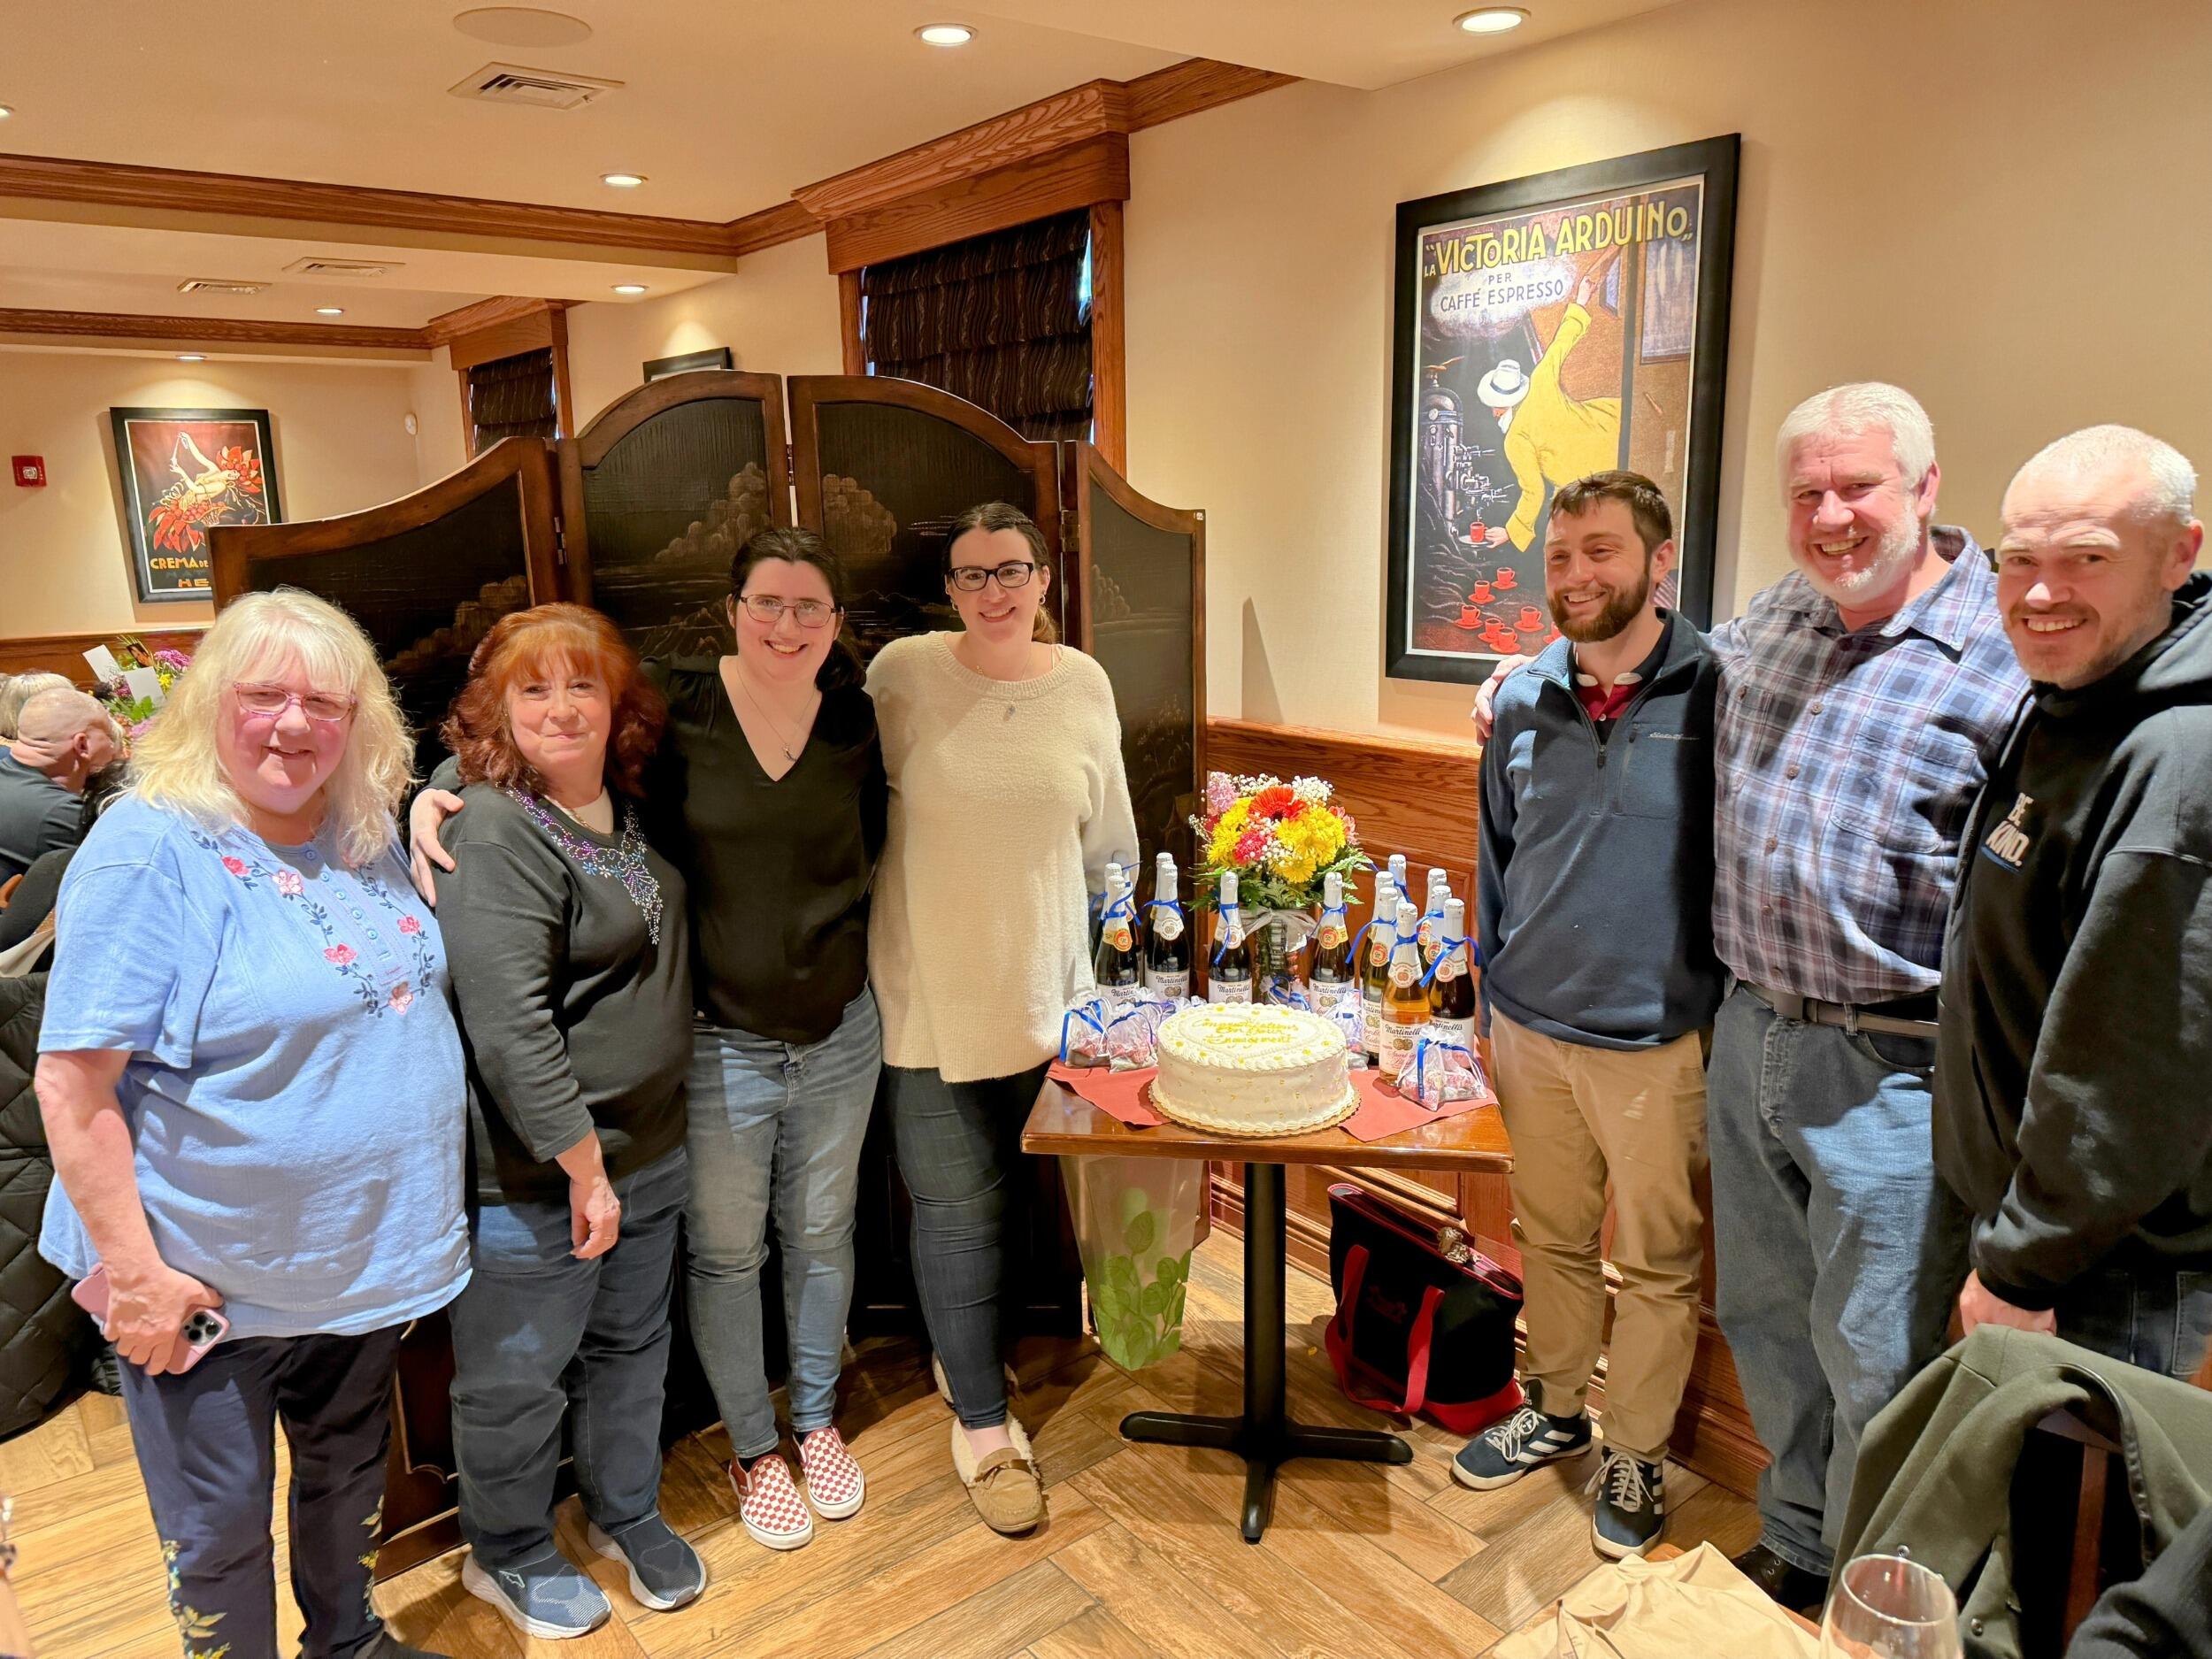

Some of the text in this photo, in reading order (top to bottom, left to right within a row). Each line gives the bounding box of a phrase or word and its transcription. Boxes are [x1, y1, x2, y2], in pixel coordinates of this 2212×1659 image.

[1424, 265, 1436, 278] LA
[1488, 273, 1512, 285] PER
[1488, 279, 1563, 305] ESPRESSO
[150, 557, 199, 570] CREMA
